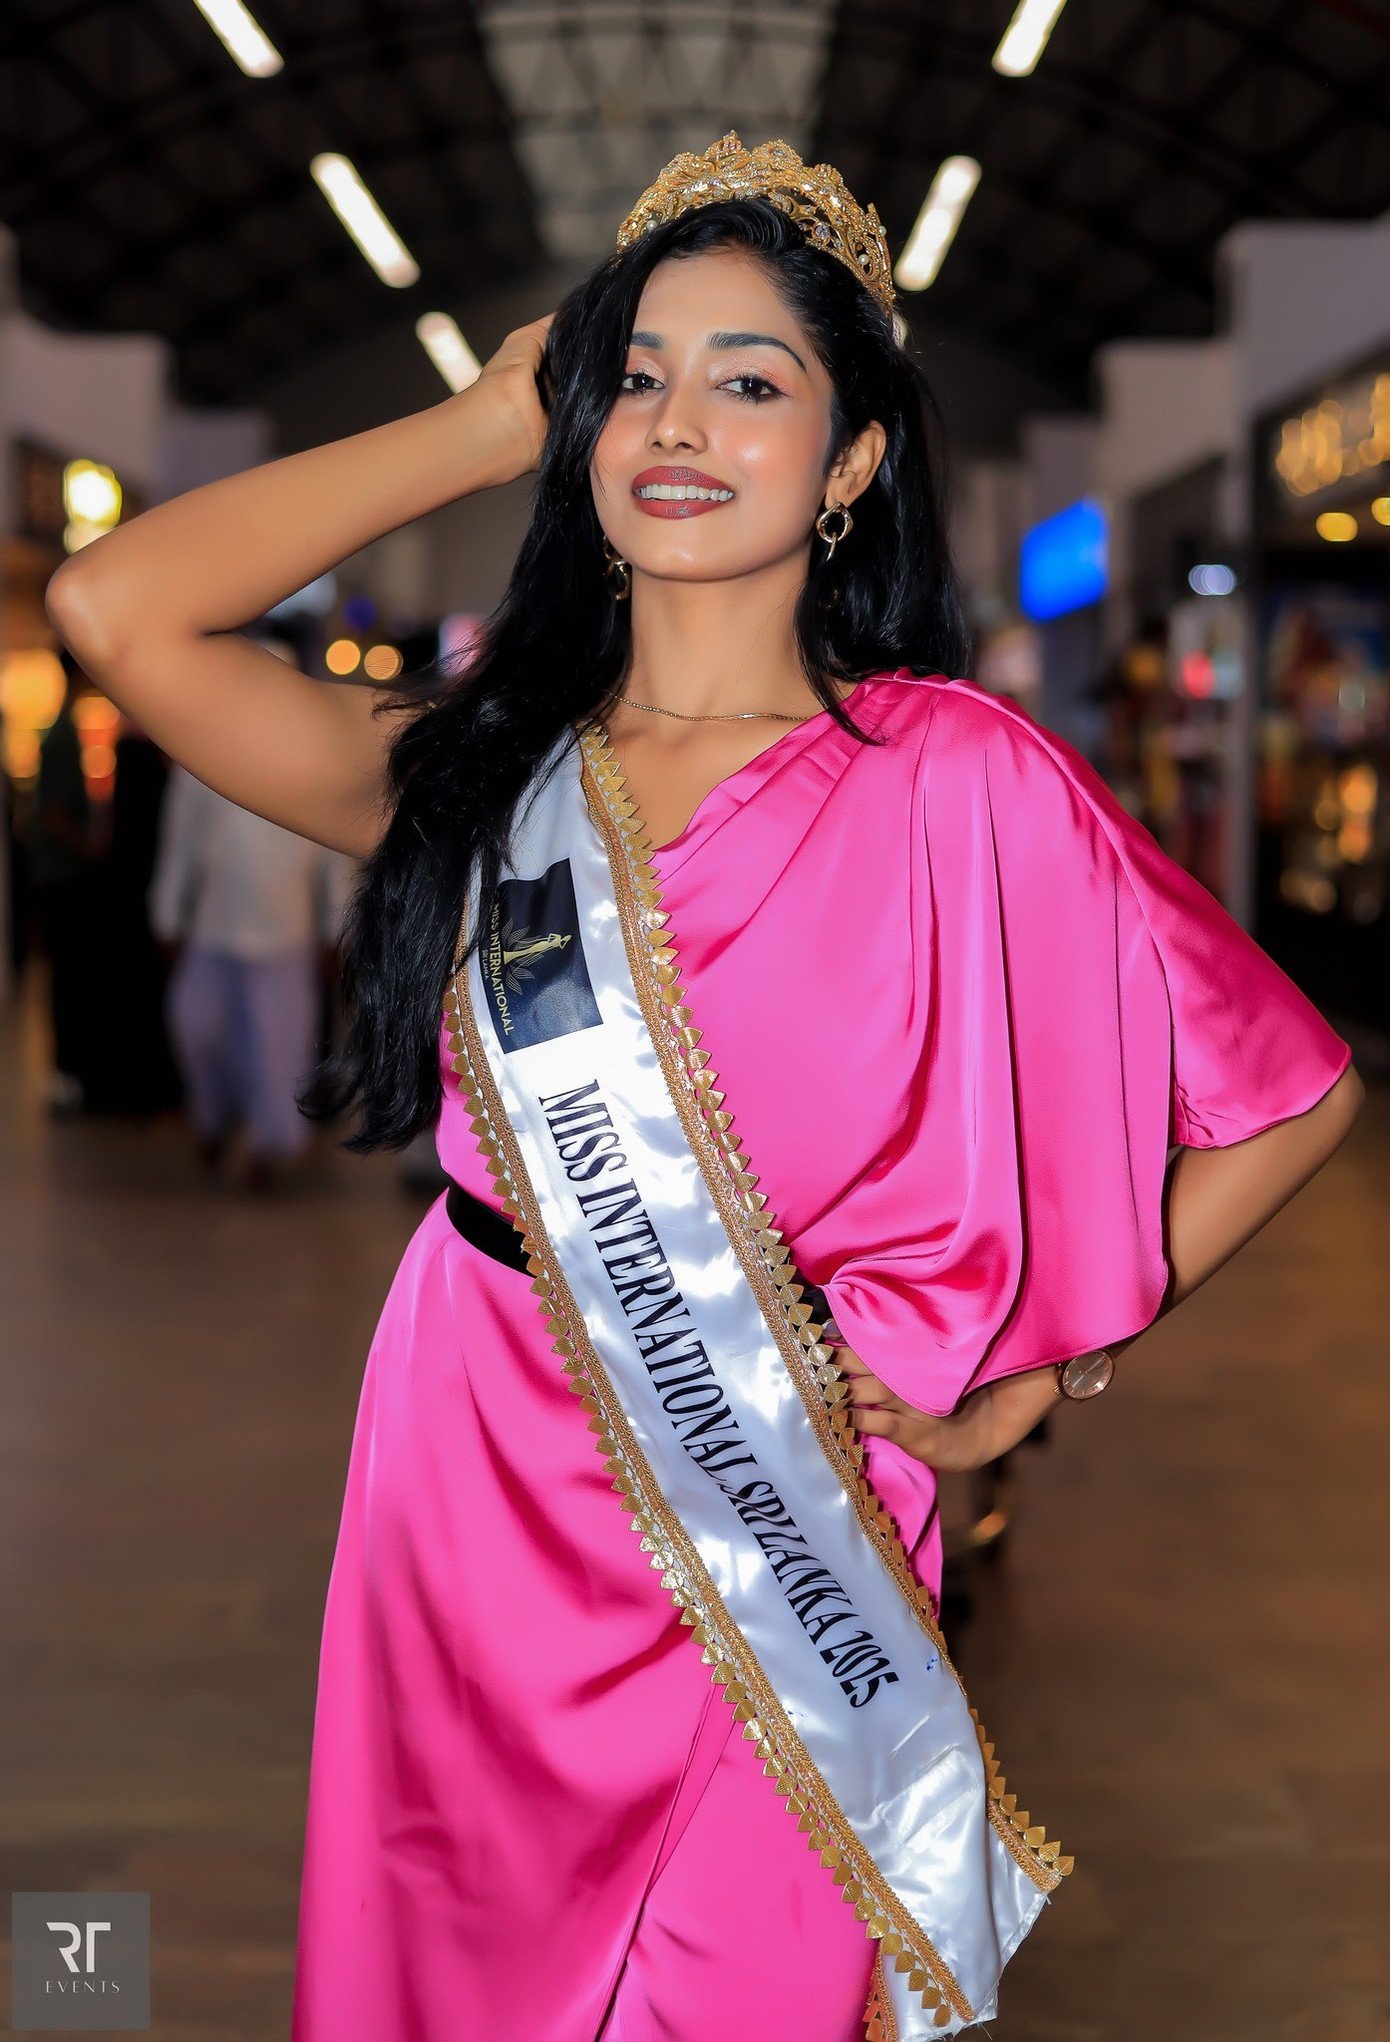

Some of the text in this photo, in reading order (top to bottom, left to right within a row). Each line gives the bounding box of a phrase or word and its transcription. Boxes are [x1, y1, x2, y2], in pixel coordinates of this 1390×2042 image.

[490, 903, 514, 1036] MISS INTERNATIONAL
[538, 1078, 900, 1708] MISS INTERNATIONAL SRI LANKA 2025
